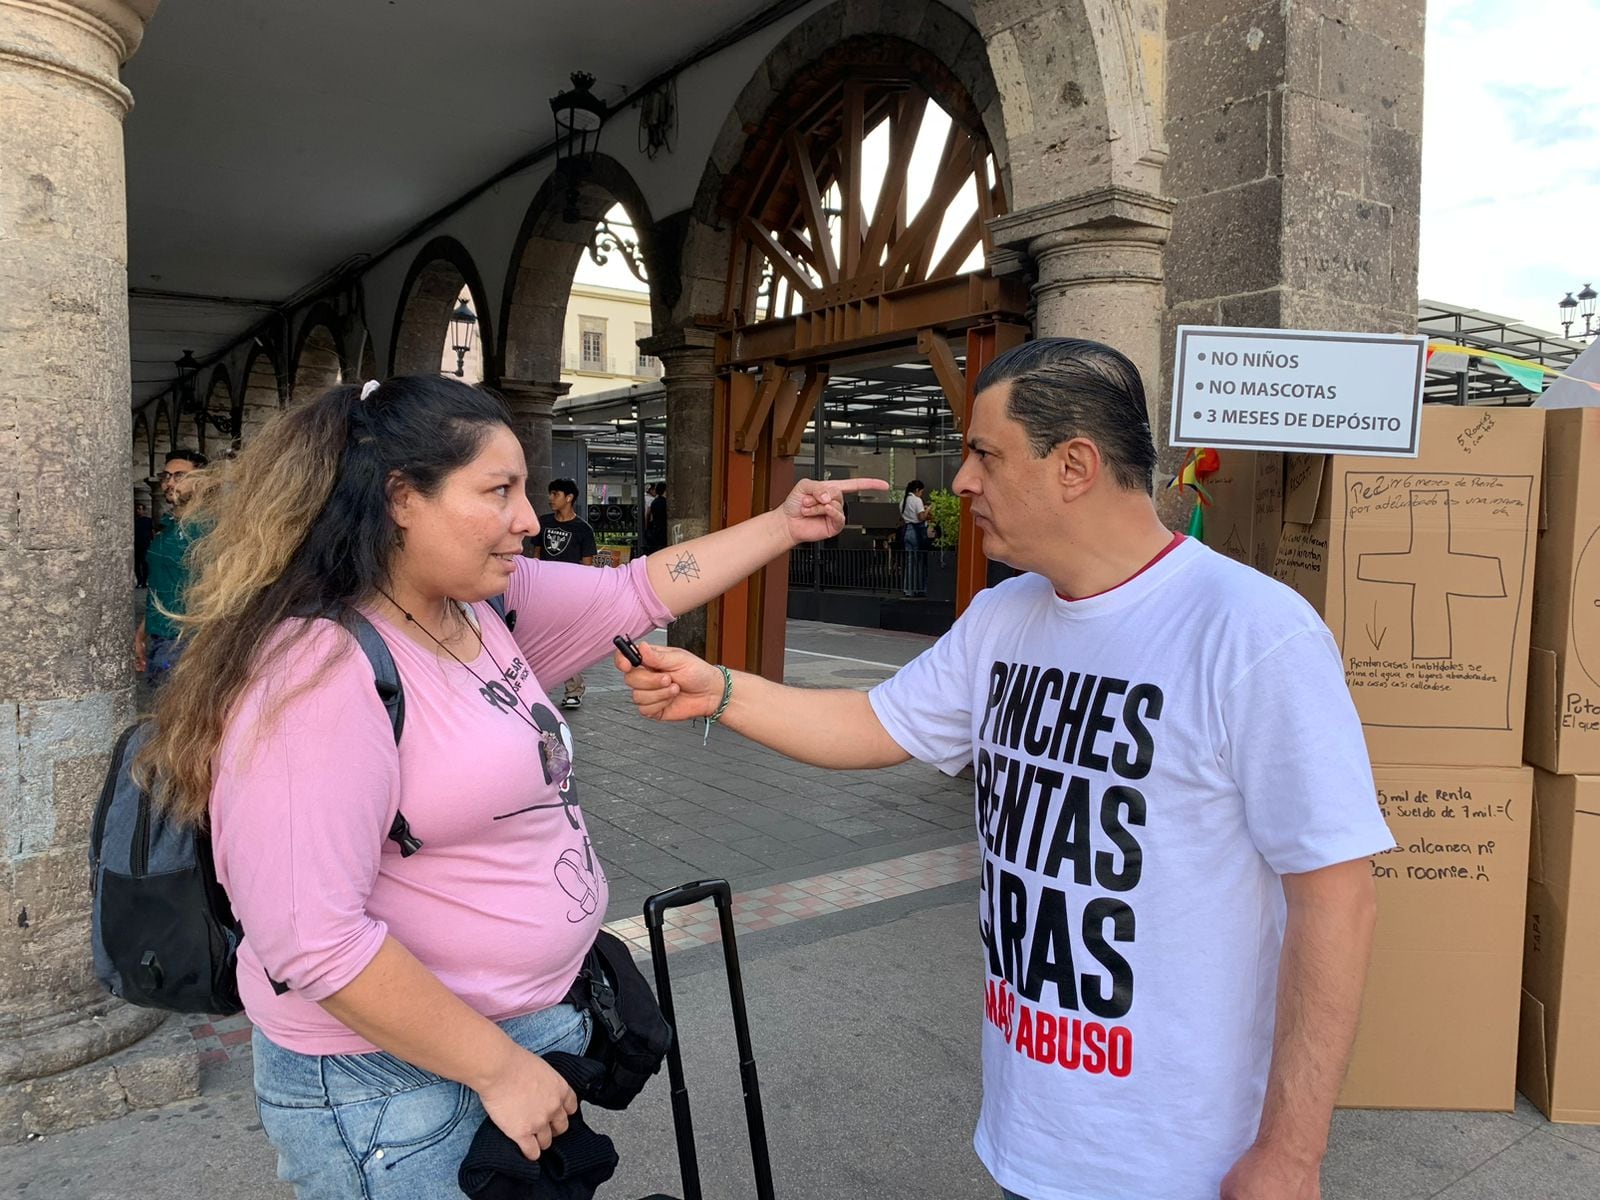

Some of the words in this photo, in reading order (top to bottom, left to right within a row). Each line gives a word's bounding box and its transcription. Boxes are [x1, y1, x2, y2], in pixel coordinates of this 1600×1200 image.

[1211, 351, 1238, 366] NO
[1243, 351, 1299, 369] NIÑOS
[1209, 380, 1236, 395] NO
[1241, 382, 1337, 399] MASCOTAS
[1207, 409, 1217, 423] 3
[1222, 410, 1279, 426] MESES
[1284, 413, 1307, 427] DE
[1312, 412, 1401, 432] DEPÓSITO
[1350, 505, 1370, 519] por
[479, 681, 518, 714] 90
[979, 660, 1164, 780] PINCHES
[1562, 714, 1575, 728] El
[1391, 790, 1408, 801] mil
[1414, 791, 1428, 803] de
[1436, 786, 1472, 801] Renta
[976, 748, 1147, 892] RENTAS
[1441, 806, 1456, 818] de
[1462, 805, 1469, 818] 7
[1409, 837, 1472, 854] alcanza
[1478, 841, 1495, 855] ni
[1532, 914, 1541, 952] TAPA
[1016, 1005, 1133, 1078] ABUSO
